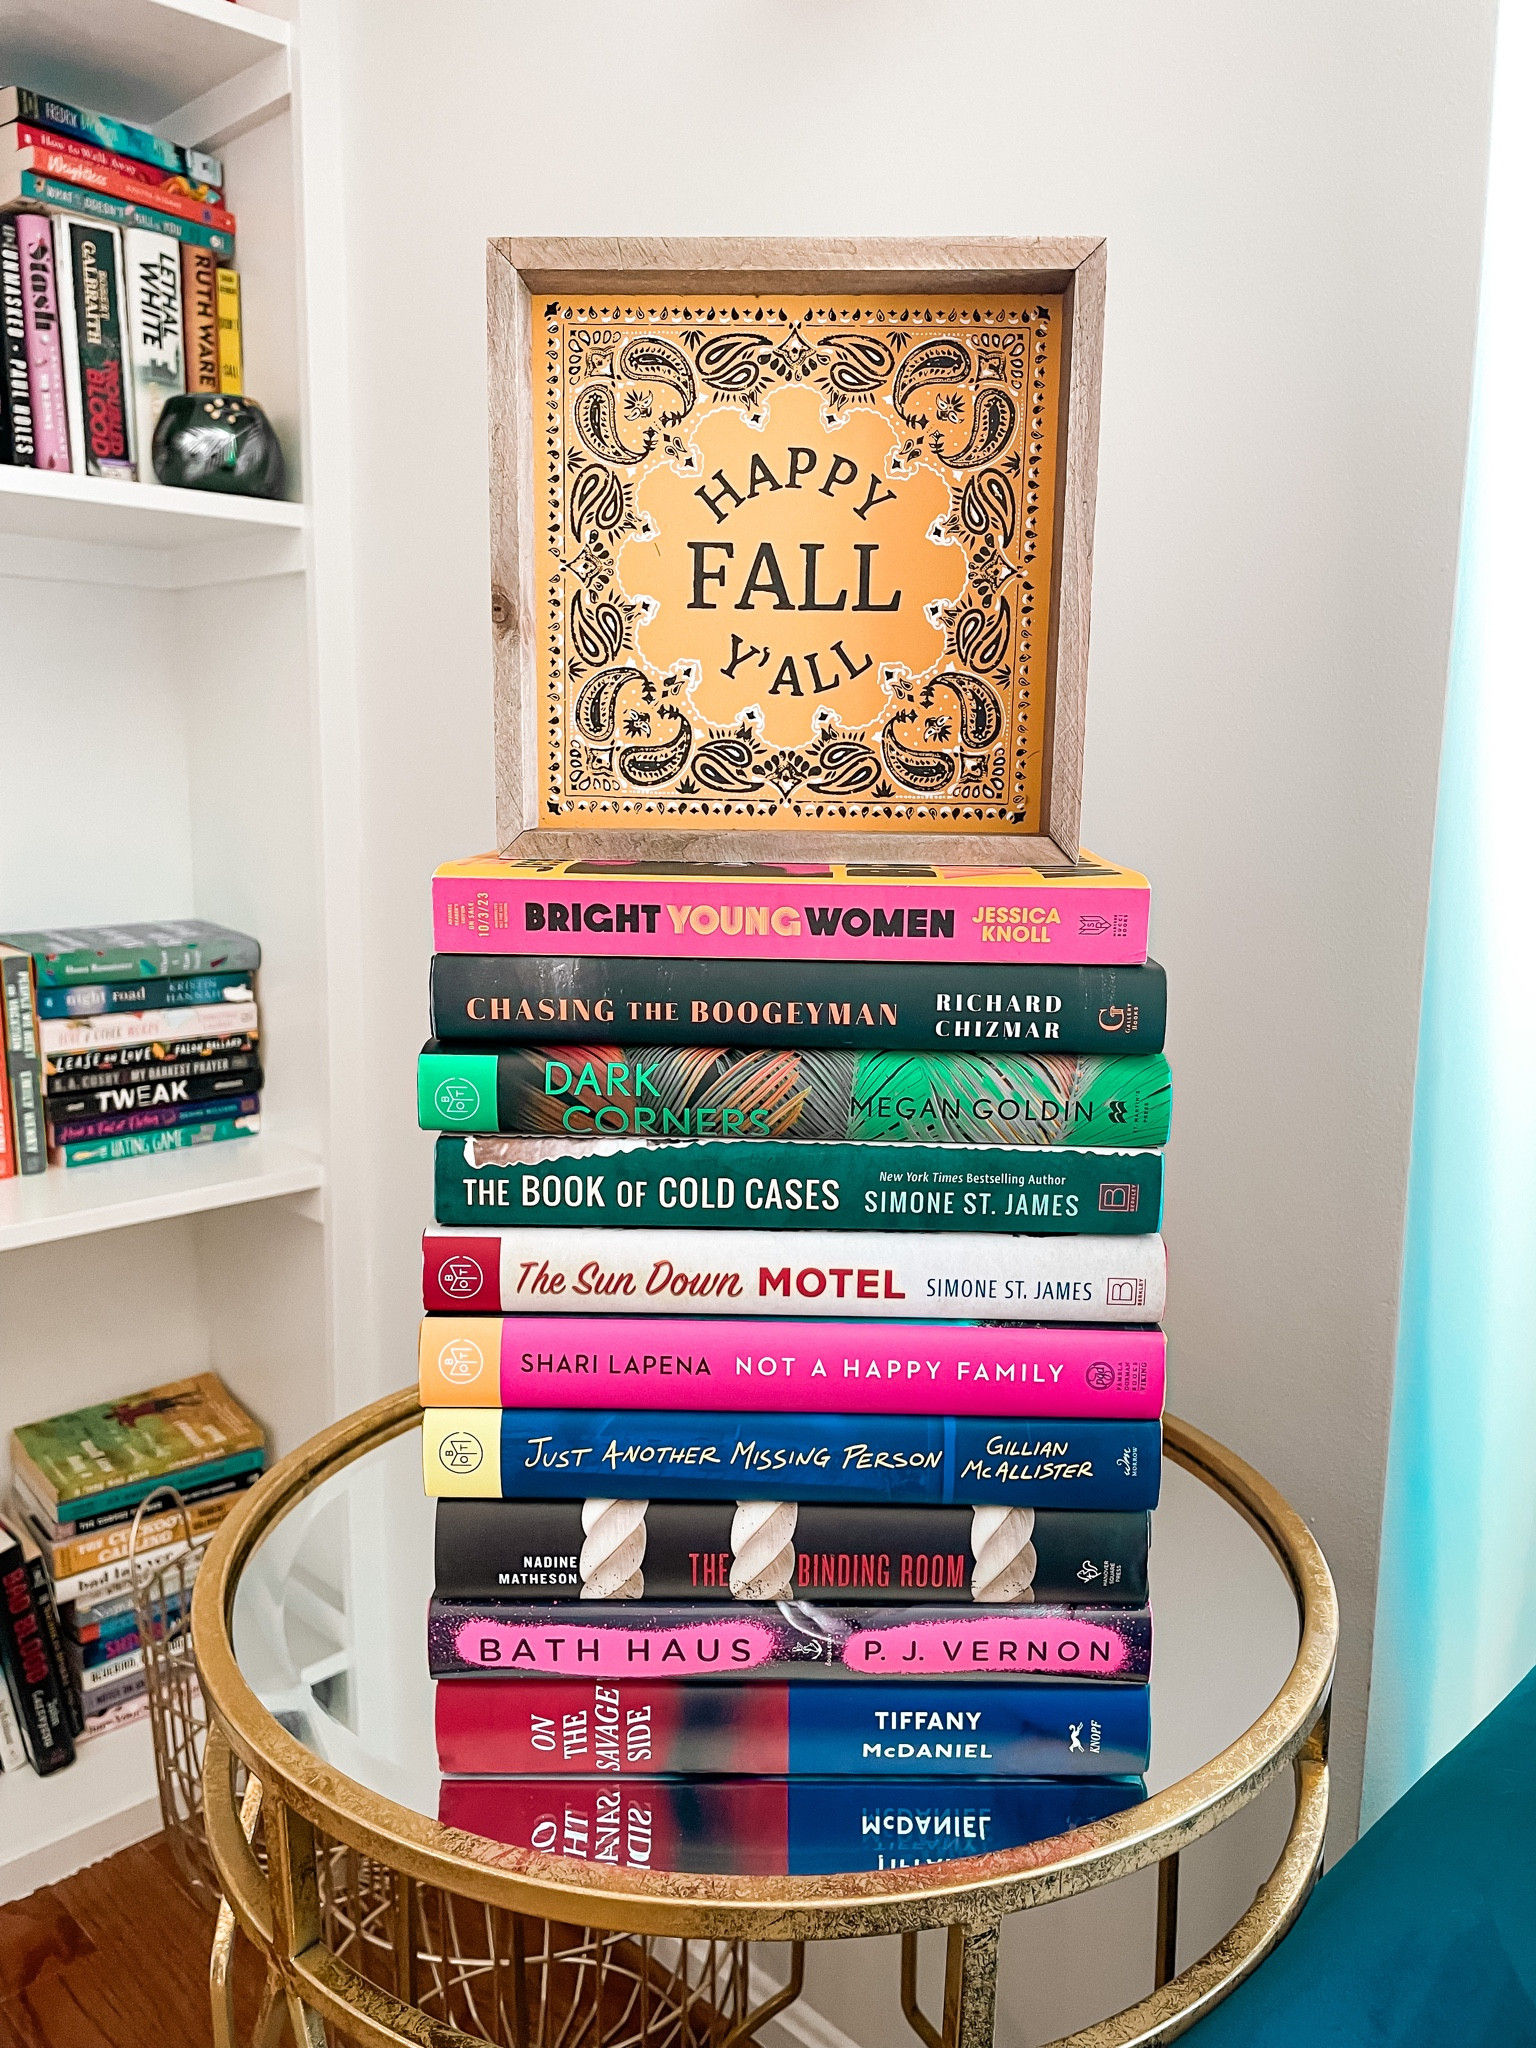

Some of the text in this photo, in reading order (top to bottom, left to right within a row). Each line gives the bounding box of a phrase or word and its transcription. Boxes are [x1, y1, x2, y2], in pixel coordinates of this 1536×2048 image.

[81, 240, 102, 345] GALBRAITH
[140, 263, 162, 349] WHITE
[159, 252, 179, 335] LETHAL
[195, 254, 216, 387] RUTH WARE
[2, 248, 34, 455] UNMASKED PAUL HOLES
[86, 368, 110, 458] BLOOD
[694, 447, 897, 524] HAPPY
[687, 542, 901, 612] FALL
[720, 633, 873, 697] Y'ALL
[467, 902, 475, 919] SALE
[477, 892, 490, 937] 10/3/23
[525, 902, 661, 934] BRIGHT
[666, 904, 801, 937] YOUNG
[804, 906, 955, 938] WOMEN
[971, 906, 1061, 924] JESSICA
[981, 925, 1051, 943] KNOLL
[112, 986, 146, 1002] road
[936, 993, 1062, 1013] RICHARD
[466, 997, 898, 1026] CHASING THE BOOGEYMAN
[935, 1020, 1060, 1039] CHIZMAR
[57, 1053, 100, 1073] LEASE
[544, 1061, 661, 1097] DARK
[95, 1079, 190, 1113] TWEAK
[850, 1097, 1093, 1121] MEGAN GOLDIN
[562, 1105, 772, 1137] CORNERS
[152, 1128, 184, 1151] GAME
[463, 1175, 840, 1211] THE BOOK OF COLD CASES
[879, 1171, 1066, 1187] New York Times Bestselling Author
[864, 1190, 1079, 1217] SIMONE ST. JAMES
[516, 1259, 905, 1299] The Sun Down MOTEL
[926, 1277, 1092, 1301] SIMONE ST. JAMES
[521, 1353, 1064, 1383] SHARI LAPENA NOT A HAPPY FAMILY
[1140, 1361, 1148, 1391] VIKING
[524, 1436, 943, 1471] JUST ANOTHER MISSING PERSON
[986, 1435, 1069, 1457] GILLIAN
[1131, 1446, 1139, 1477] MORROW
[960, 1459, 1094, 1483] McALLISTER
[498, 1572, 578, 1585] MATHESON
[523, 1556, 578, 1569] NADINE
[689, 1553, 965, 1588] THE BINDING ROOM
[2, 1567, 31, 1615] BAD
[13, 1612, 50, 1684] BLOOD
[479, 1637, 752, 1662] BATH HAUS
[864, 1640, 1110, 1662] P. J. VERNON
[531, 1714, 556, 1751] ON
[562, 1710, 588, 1760] THE
[594, 1685, 621, 1772] SAVAGE
[626, 1705, 652, 1762] SIDE
[875, 1711, 982, 1730] TIFFANY
[862, 1743, 993, 1759] McDANIEL
[1090, 1720, 1102, 1754] KNOPF
